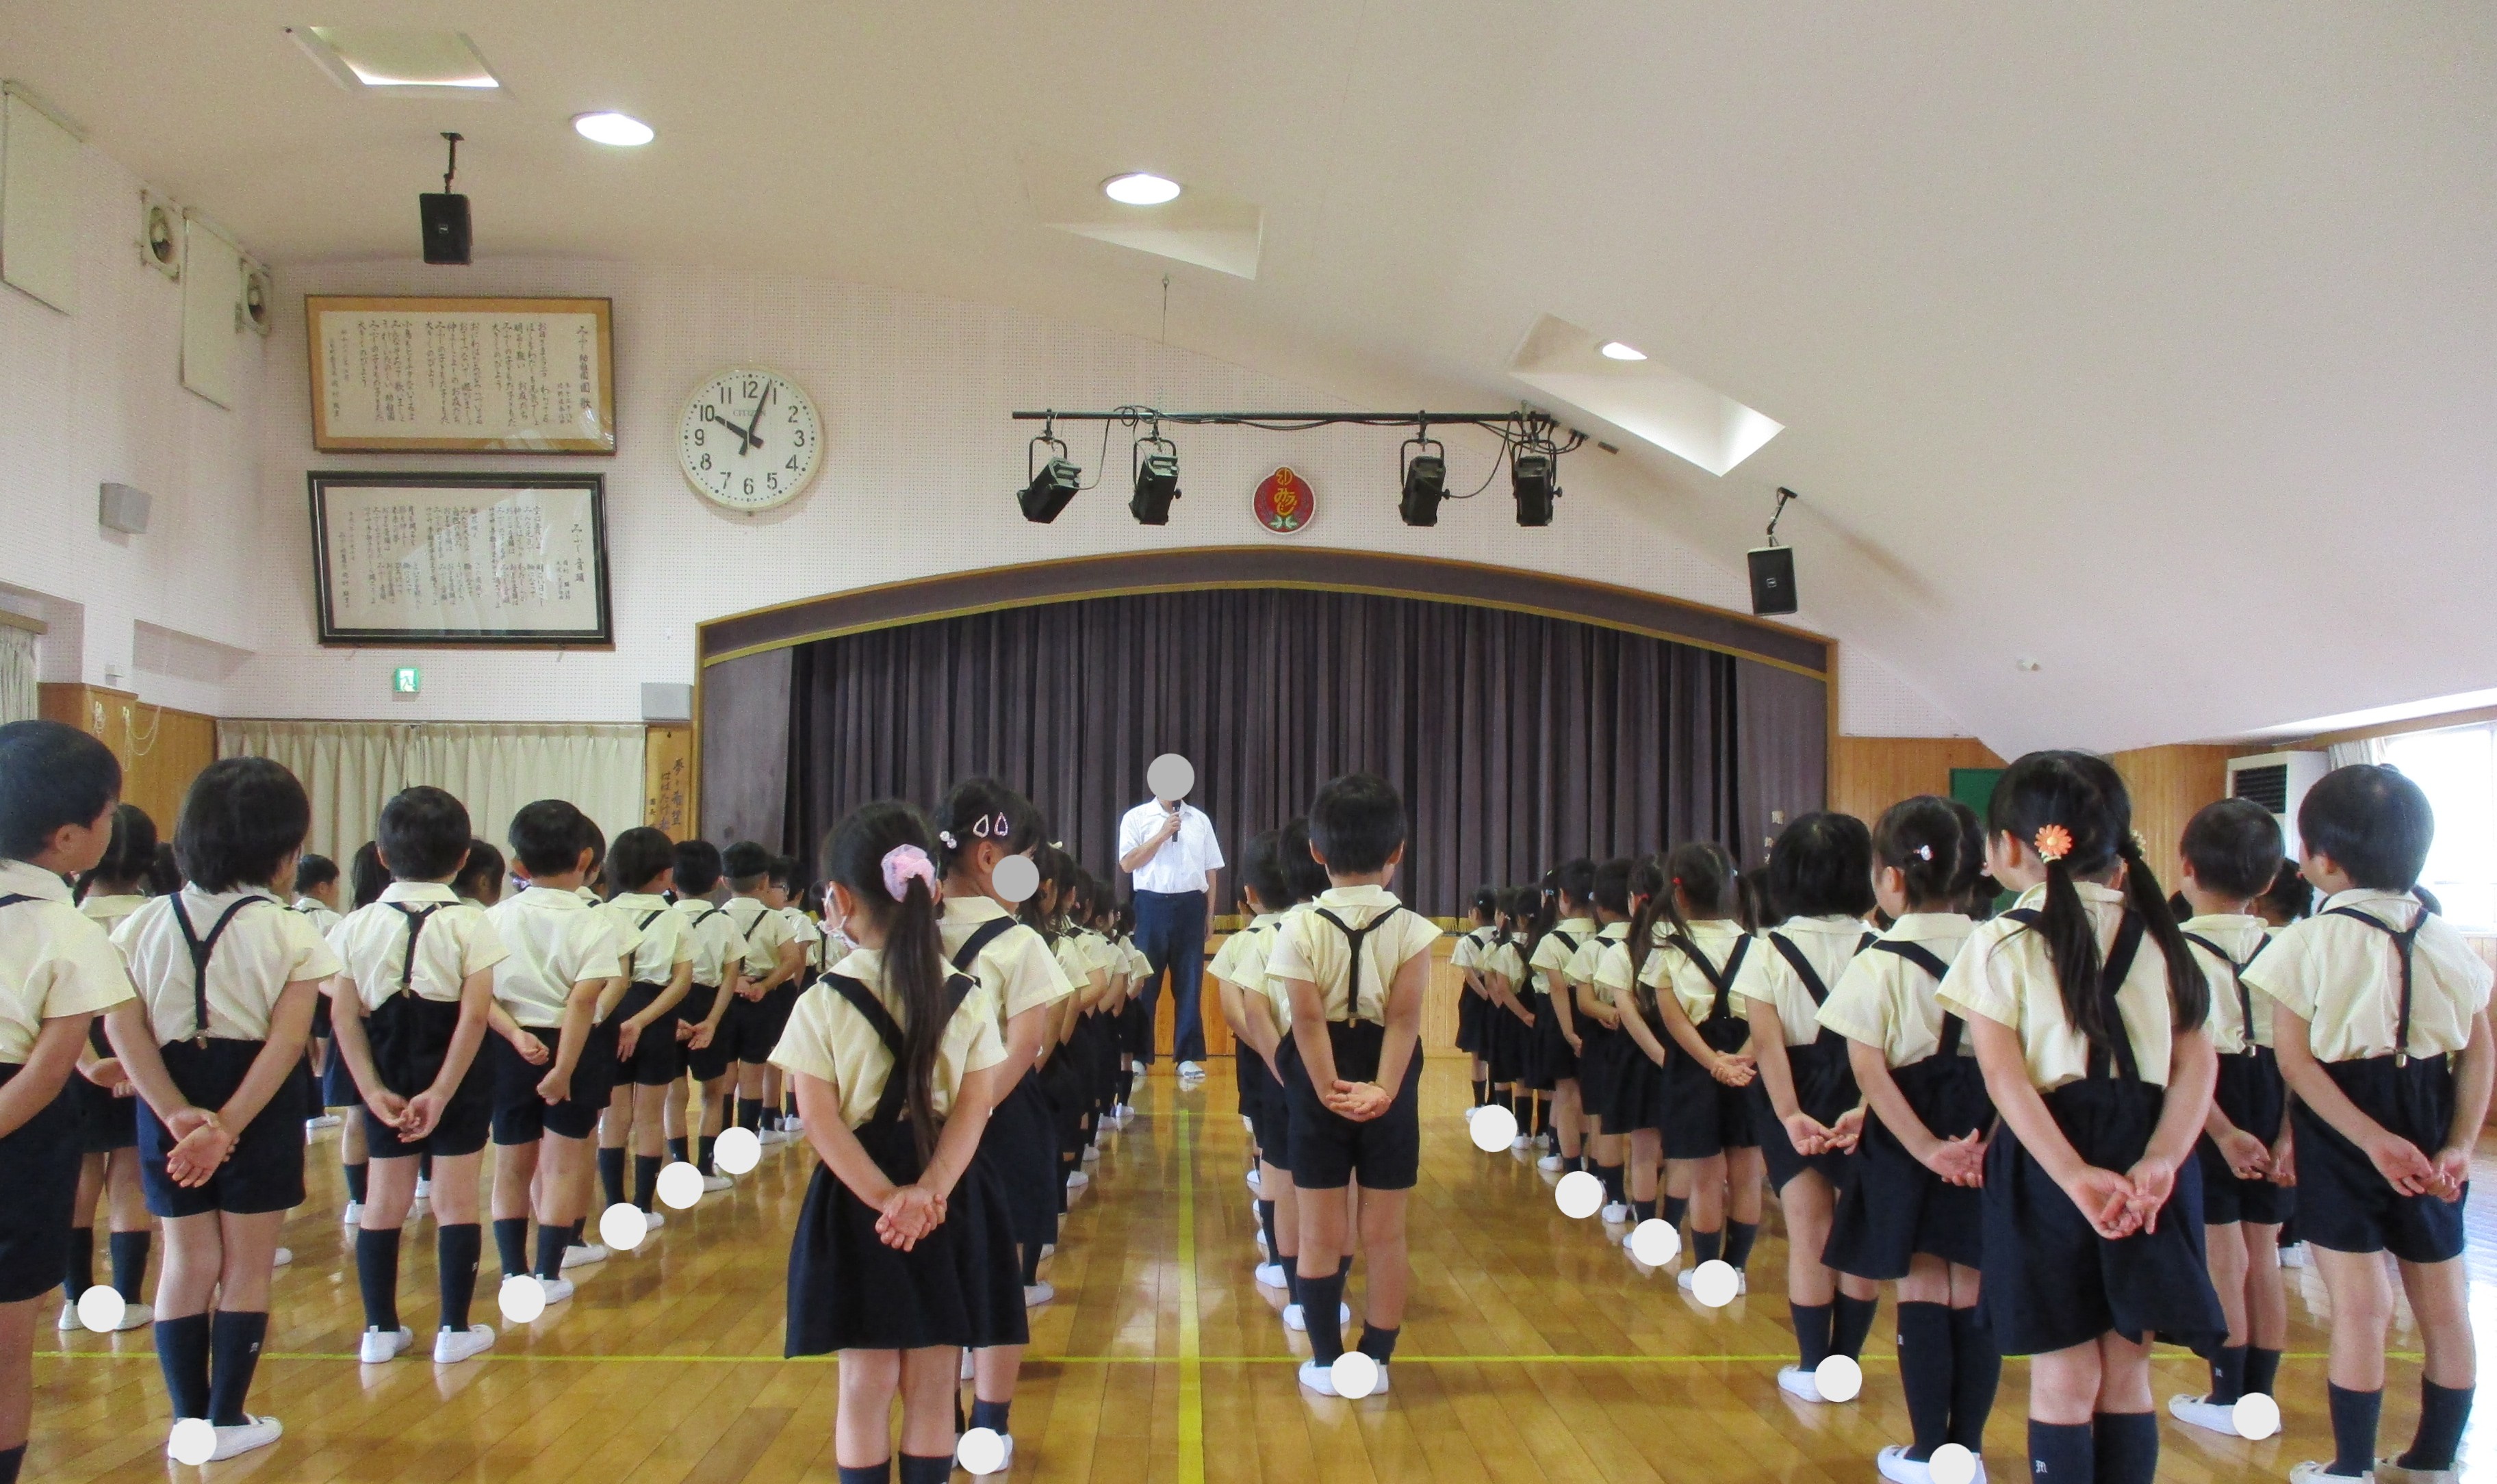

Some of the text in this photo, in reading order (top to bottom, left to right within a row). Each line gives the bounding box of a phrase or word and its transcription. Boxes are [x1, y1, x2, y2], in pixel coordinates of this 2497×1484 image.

[721, 387, 732, 404] 11
[743, 381, 758, 398] 12
[773, 388, 777, 405] 1
[700, 405, 715, 422] 10
[788, 406, 798, 423] 2
[695, 429, 704, 446] 9
[794, 430, 804, 447] 3
[700, 453, 712, 470] 8
[785, 455, 799, 472] 4
[720, 472, 731, 489] 7
[743, 478, 754, 495] 6
[767, 473, 778, 490] 5
